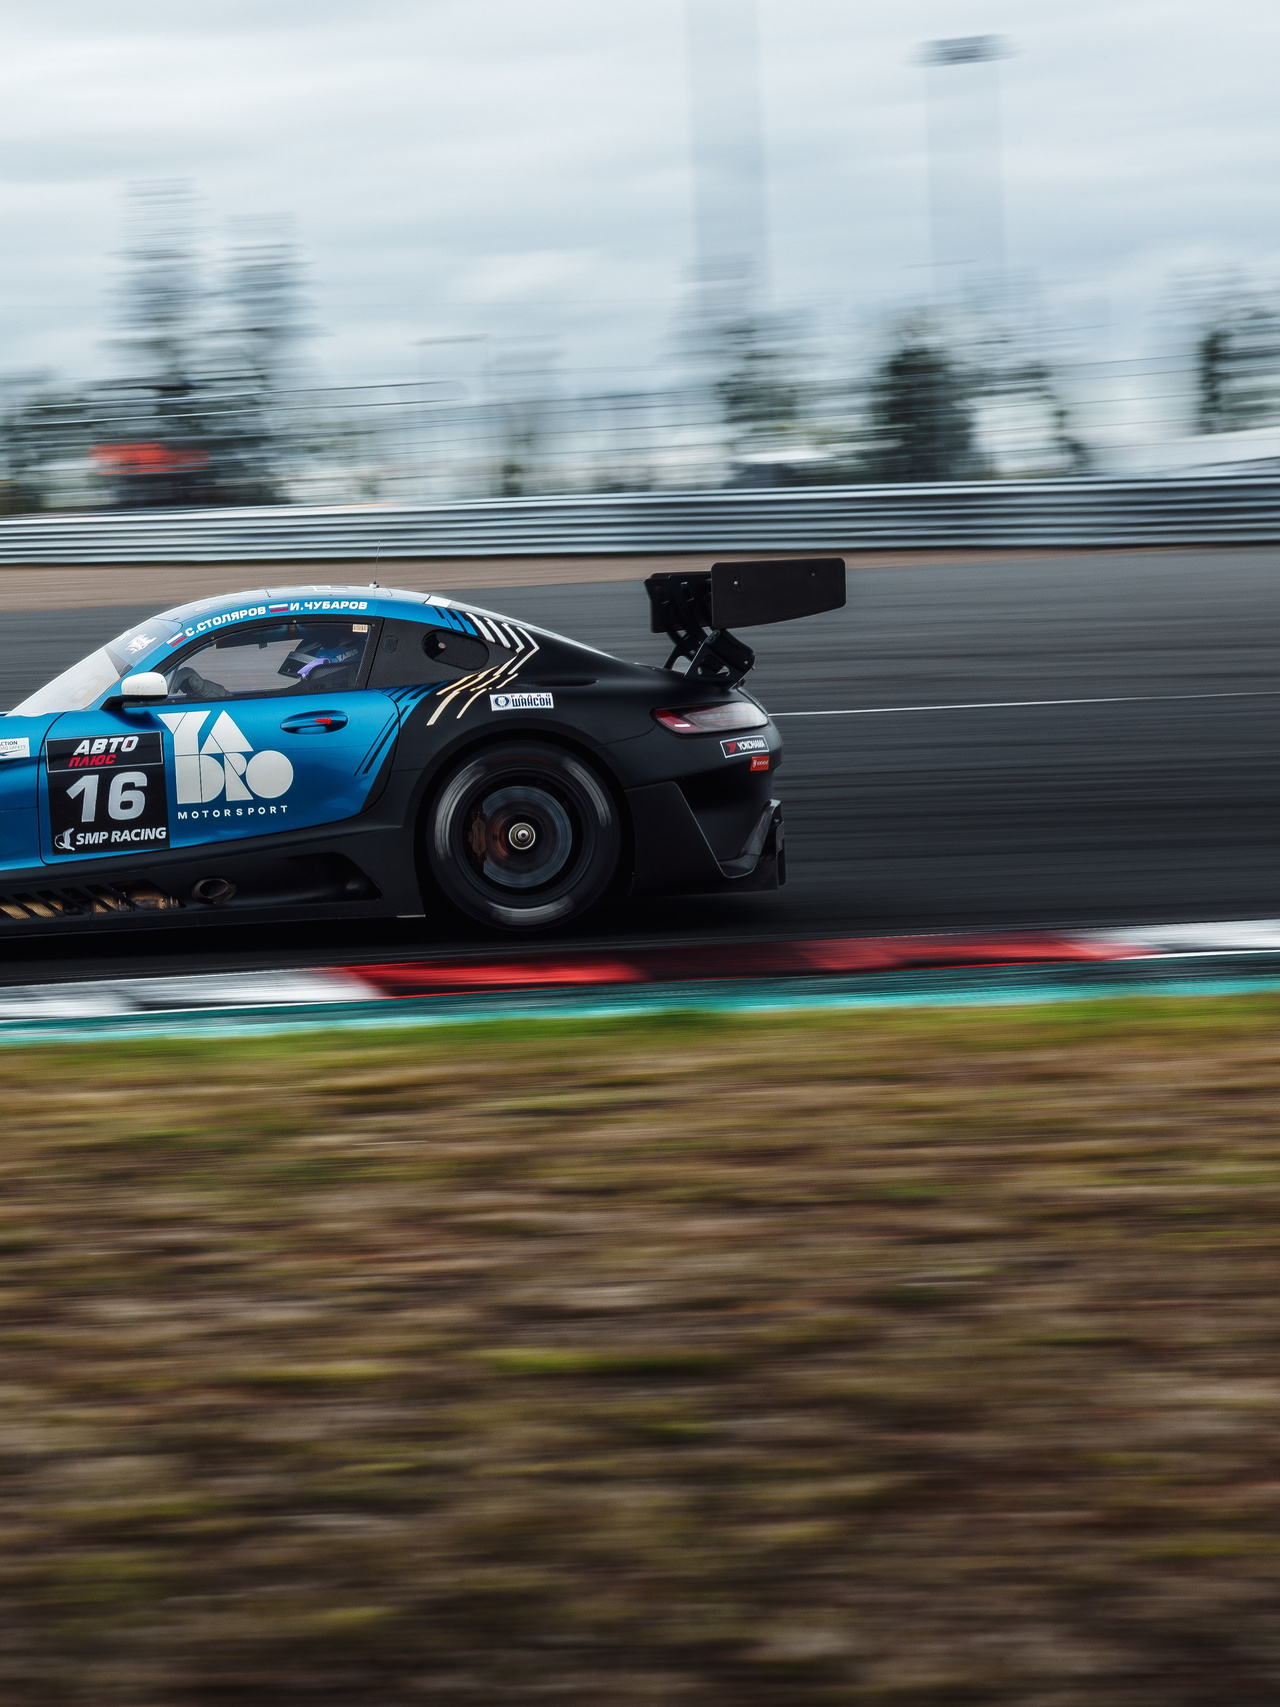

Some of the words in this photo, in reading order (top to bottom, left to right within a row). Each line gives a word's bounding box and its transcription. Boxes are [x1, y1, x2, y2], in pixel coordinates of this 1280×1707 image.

[289, 601, 368, 612] И.ЧУБАРОВ
[185, 606, 267, 637] С.СТОЛЯРОВ
[512, 697, 552, 707] ШАНСОН
[73, 735, 139, 756] АВТО
[68, 754, 116, 767] ПЛЮС
[66, 771, 148, 823] 16
[177, 805, 288, 820] MOTORSPORT
[75, 831, 108, 845] SMP
[111, 827, 167, 843] RACING
